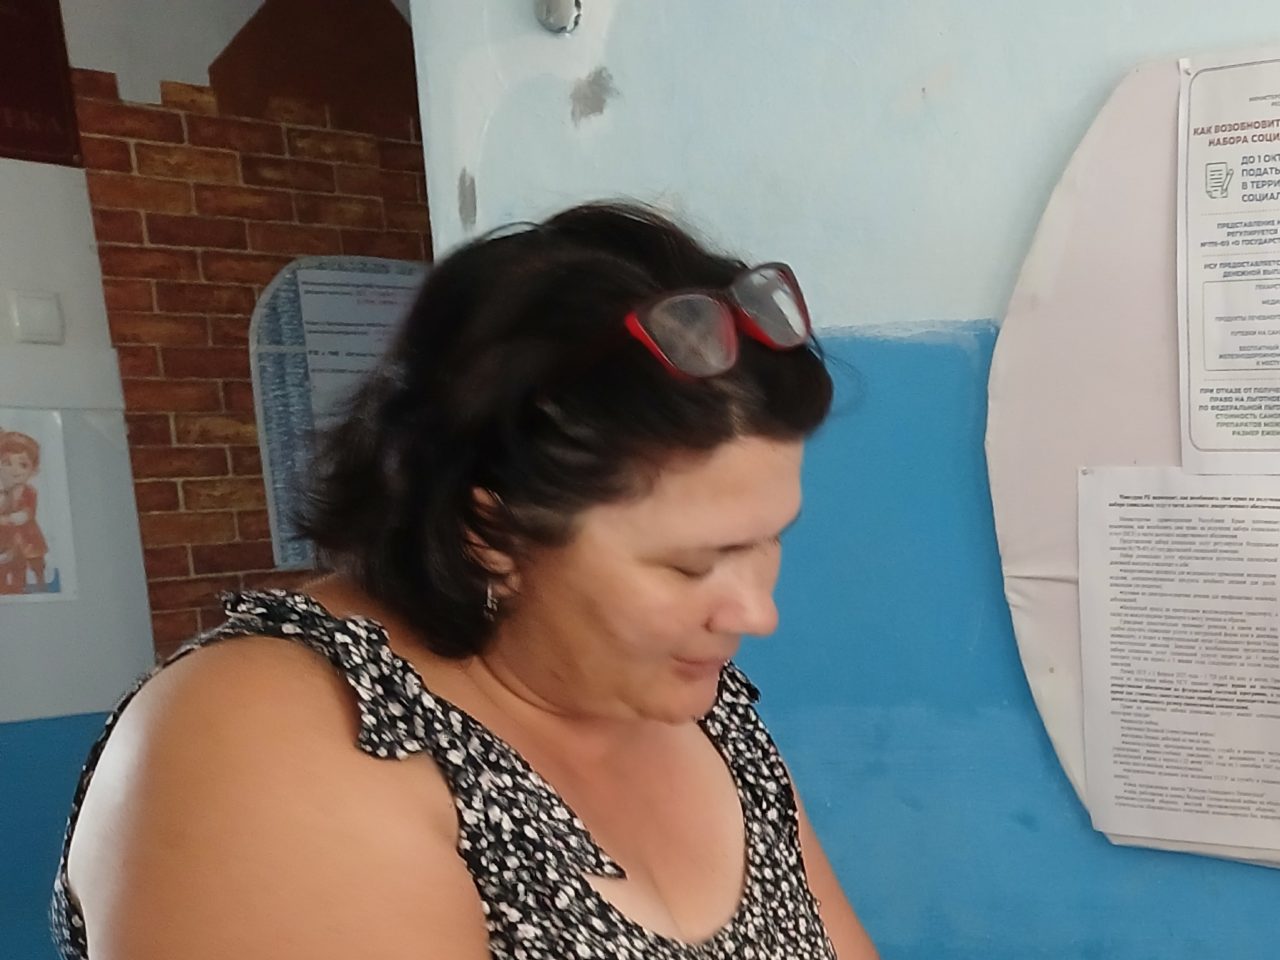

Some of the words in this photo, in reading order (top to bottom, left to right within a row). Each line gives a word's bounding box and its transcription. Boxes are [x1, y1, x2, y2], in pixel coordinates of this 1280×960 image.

[1193, 126, 1212, 136] КАК
[1208, 135, 1249, 147] НАБОРА
[1241, 155, 1255, 165] ДО
[1241, 166, 1280, 177] ПОДАТЬ
[1241, 181, 1248, 190] В
